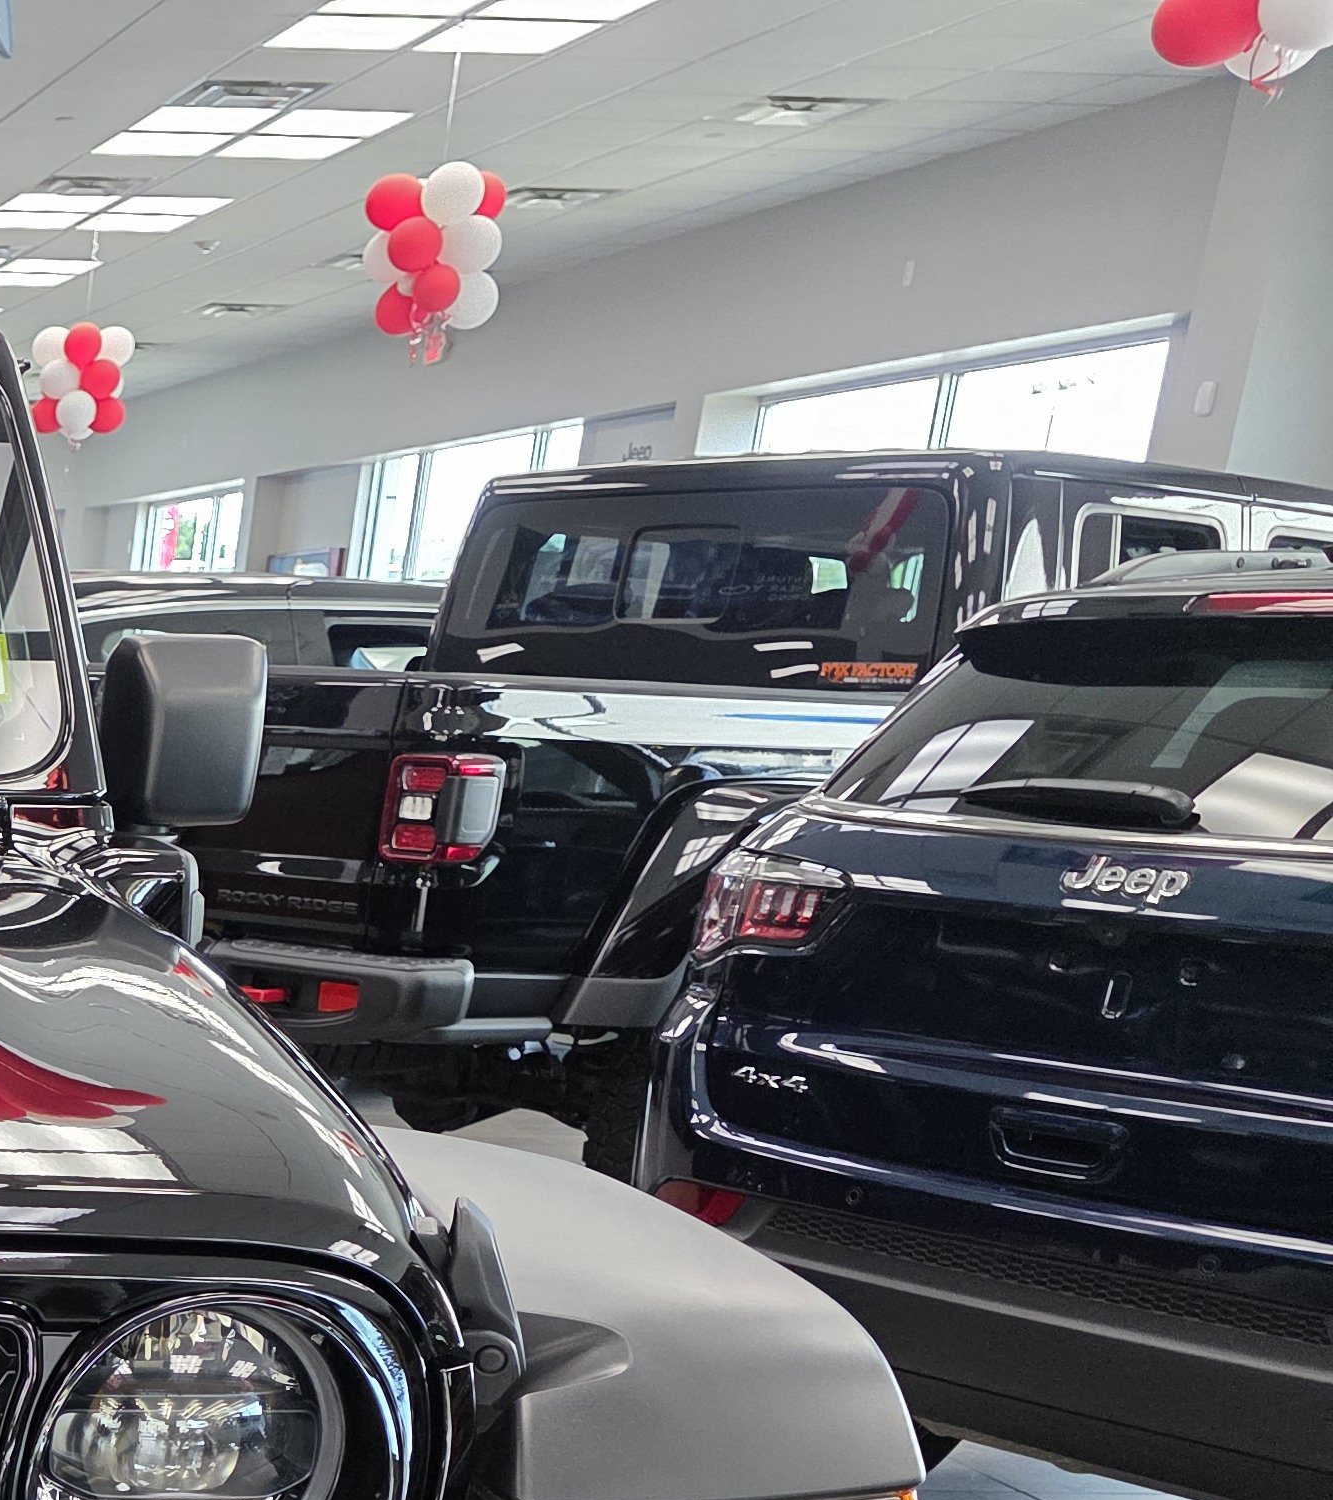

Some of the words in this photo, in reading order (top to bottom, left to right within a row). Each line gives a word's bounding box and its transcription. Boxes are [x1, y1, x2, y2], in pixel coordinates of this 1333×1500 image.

[851, 661, 918, 678] FACTORY
[1062, 853, 1190, 905] Jeep
[217, 888, 285, 907] ROCKY
[287, 895, 359, 915] RIDGE
[730, 1065, 810, 1094] 4x4
